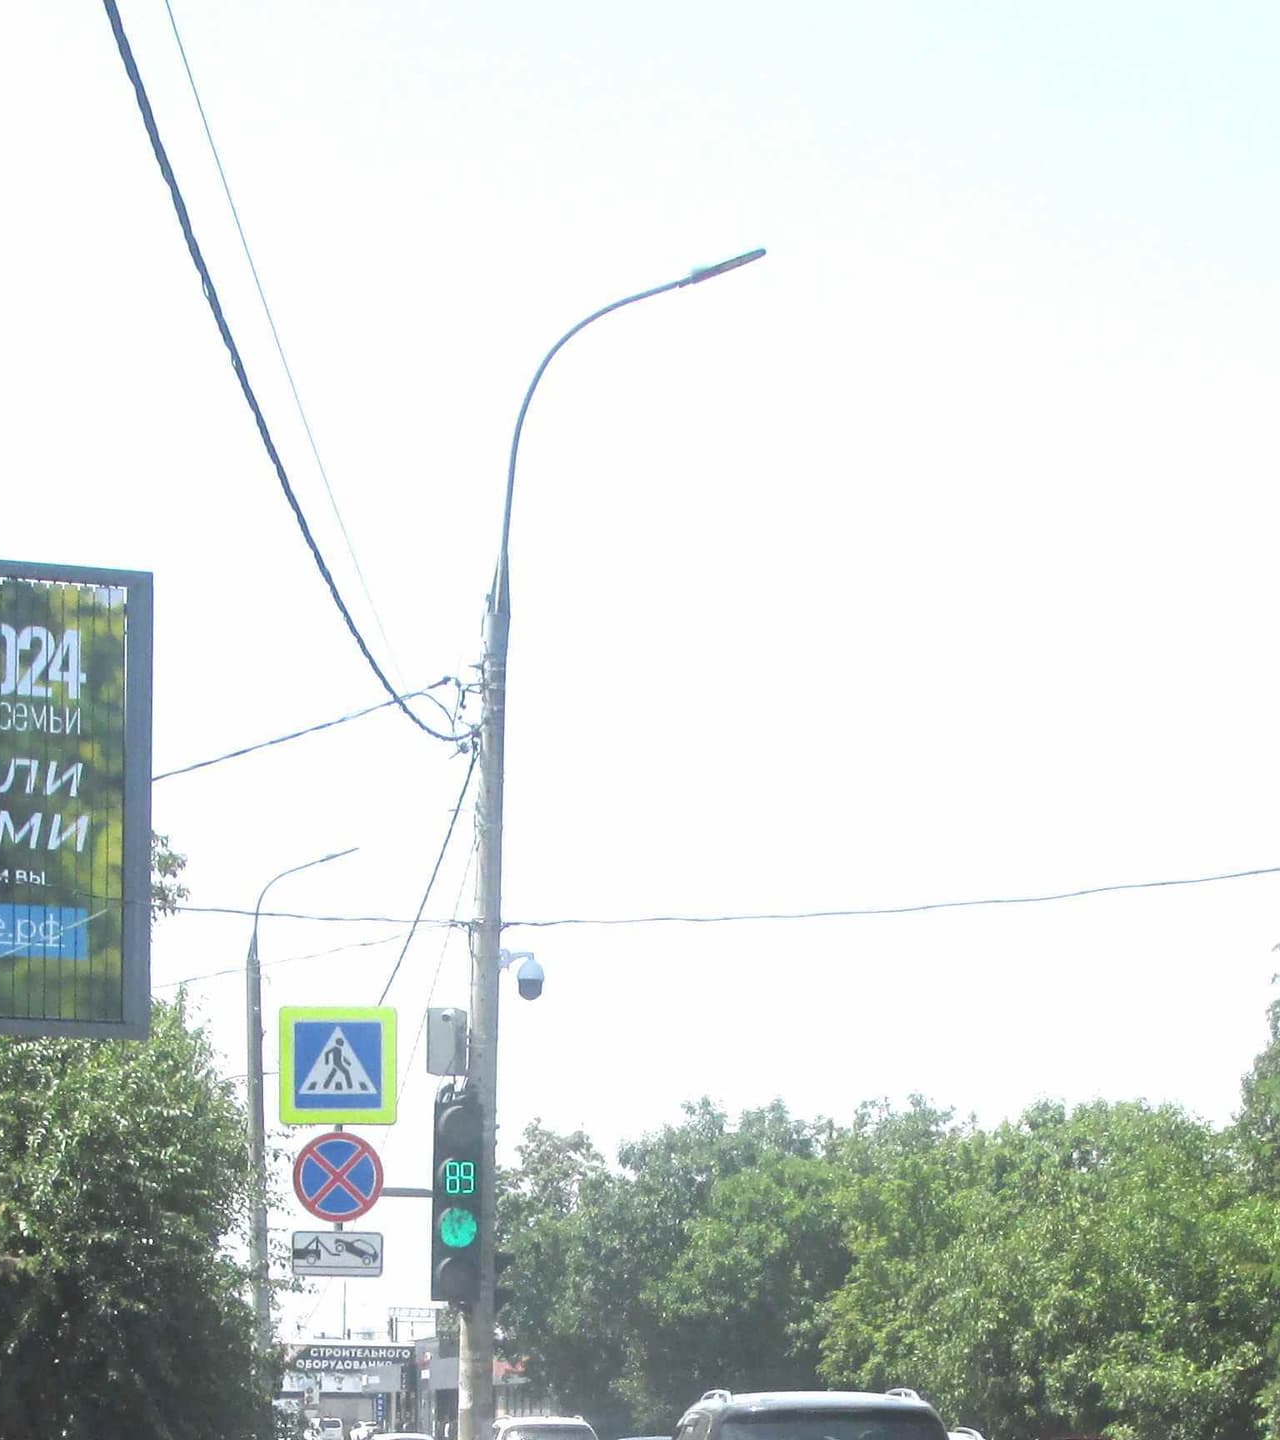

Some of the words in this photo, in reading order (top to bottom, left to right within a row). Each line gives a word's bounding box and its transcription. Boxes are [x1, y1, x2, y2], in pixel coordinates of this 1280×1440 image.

[15, 869, 47, 887] ВЫ
[446, 1161, 475, 1194] 89
[309, 1347, 412, 1359] СТРОИТЕЛЬНОГО
